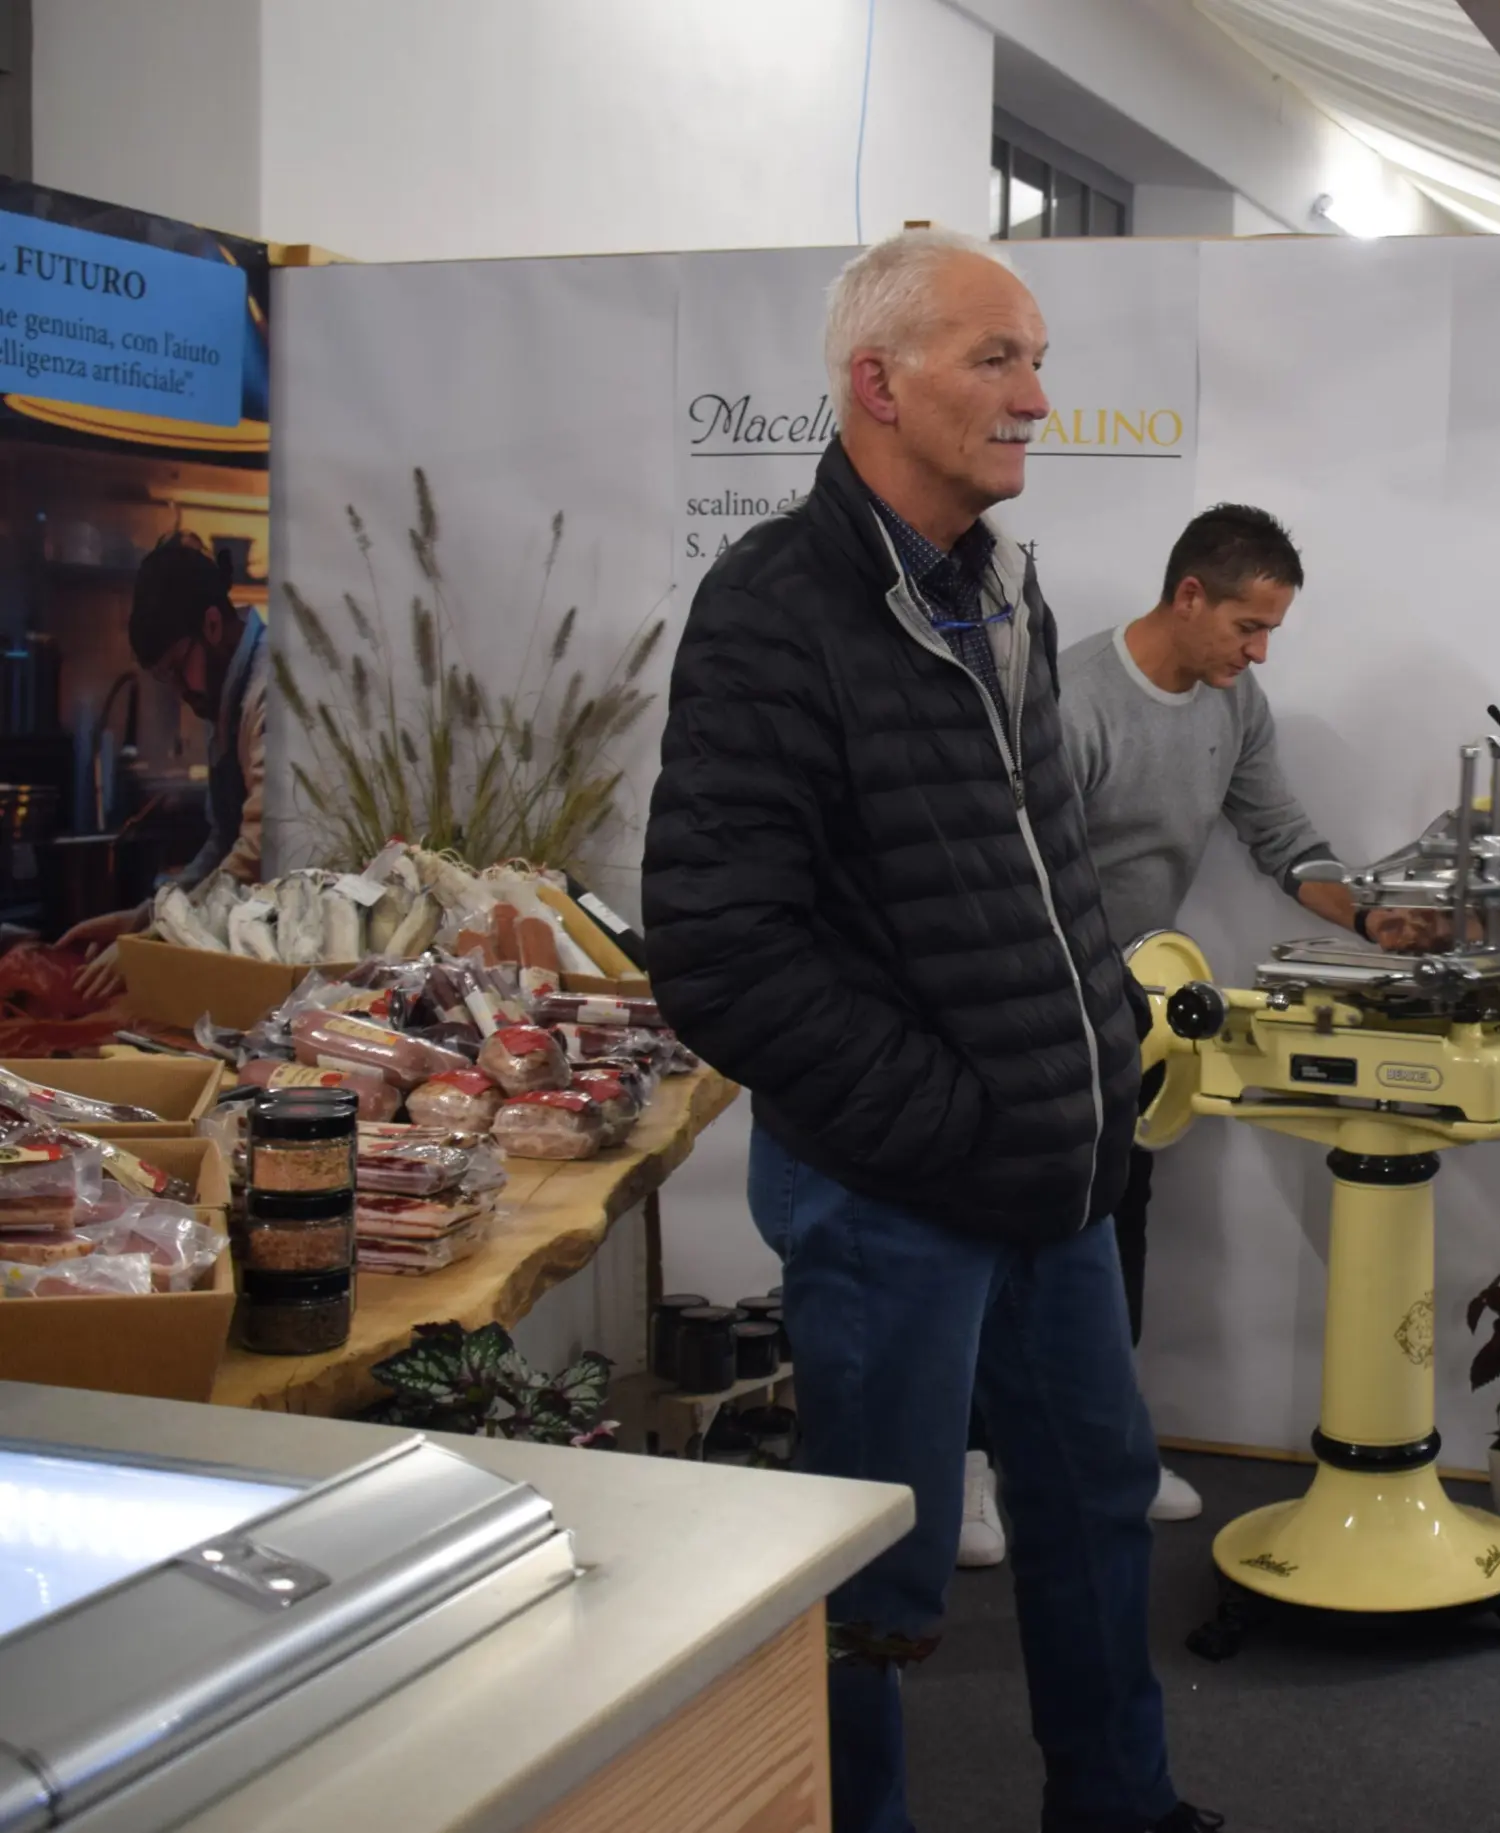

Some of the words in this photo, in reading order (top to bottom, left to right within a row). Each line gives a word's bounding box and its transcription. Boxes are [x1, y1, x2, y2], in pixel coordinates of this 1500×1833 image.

[14, 245, 147, 300] FUTURO
[0, 337, 88, 379] lligenza
[25, 312, 114, 350] genuina,
[121, 331, 158, 355] con
[164, 331, 221, 366] l'aiuto
[1038, 408, 1184, 447] ALINO
[686, 532, 706, 558] S.
